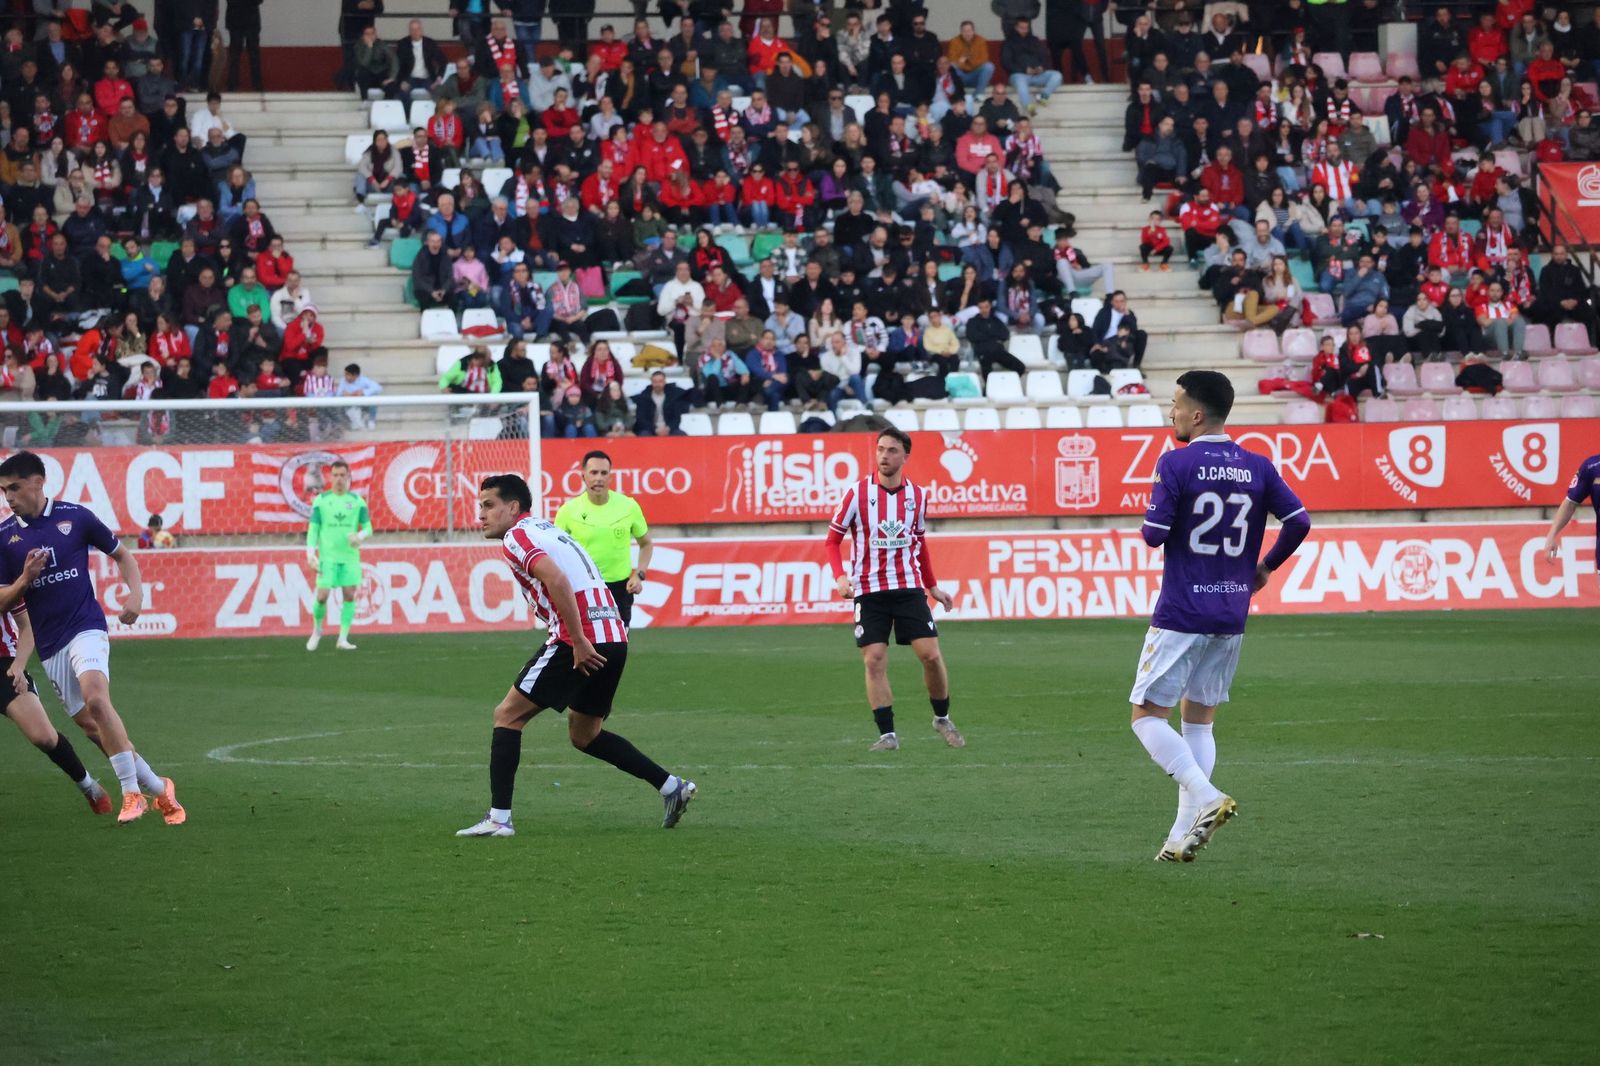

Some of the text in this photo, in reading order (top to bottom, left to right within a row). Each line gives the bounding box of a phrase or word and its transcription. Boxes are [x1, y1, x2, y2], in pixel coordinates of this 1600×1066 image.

[753, 439, 859, 487] fisio
[1197, 466, 1252, 483] J.CASADO
[1409, 434, 1433, 475] 8
[1488, 452, 1531, 501] ZAMORA
[1522, 432, 1547, 473] 8
[1375, 454, 1417, 503] ZAMORA
[1189, 491, 1252, 557] 23
[1281, 537, 1519, 603] ZAMORA
[1520, 536, 1597, 599] CF
